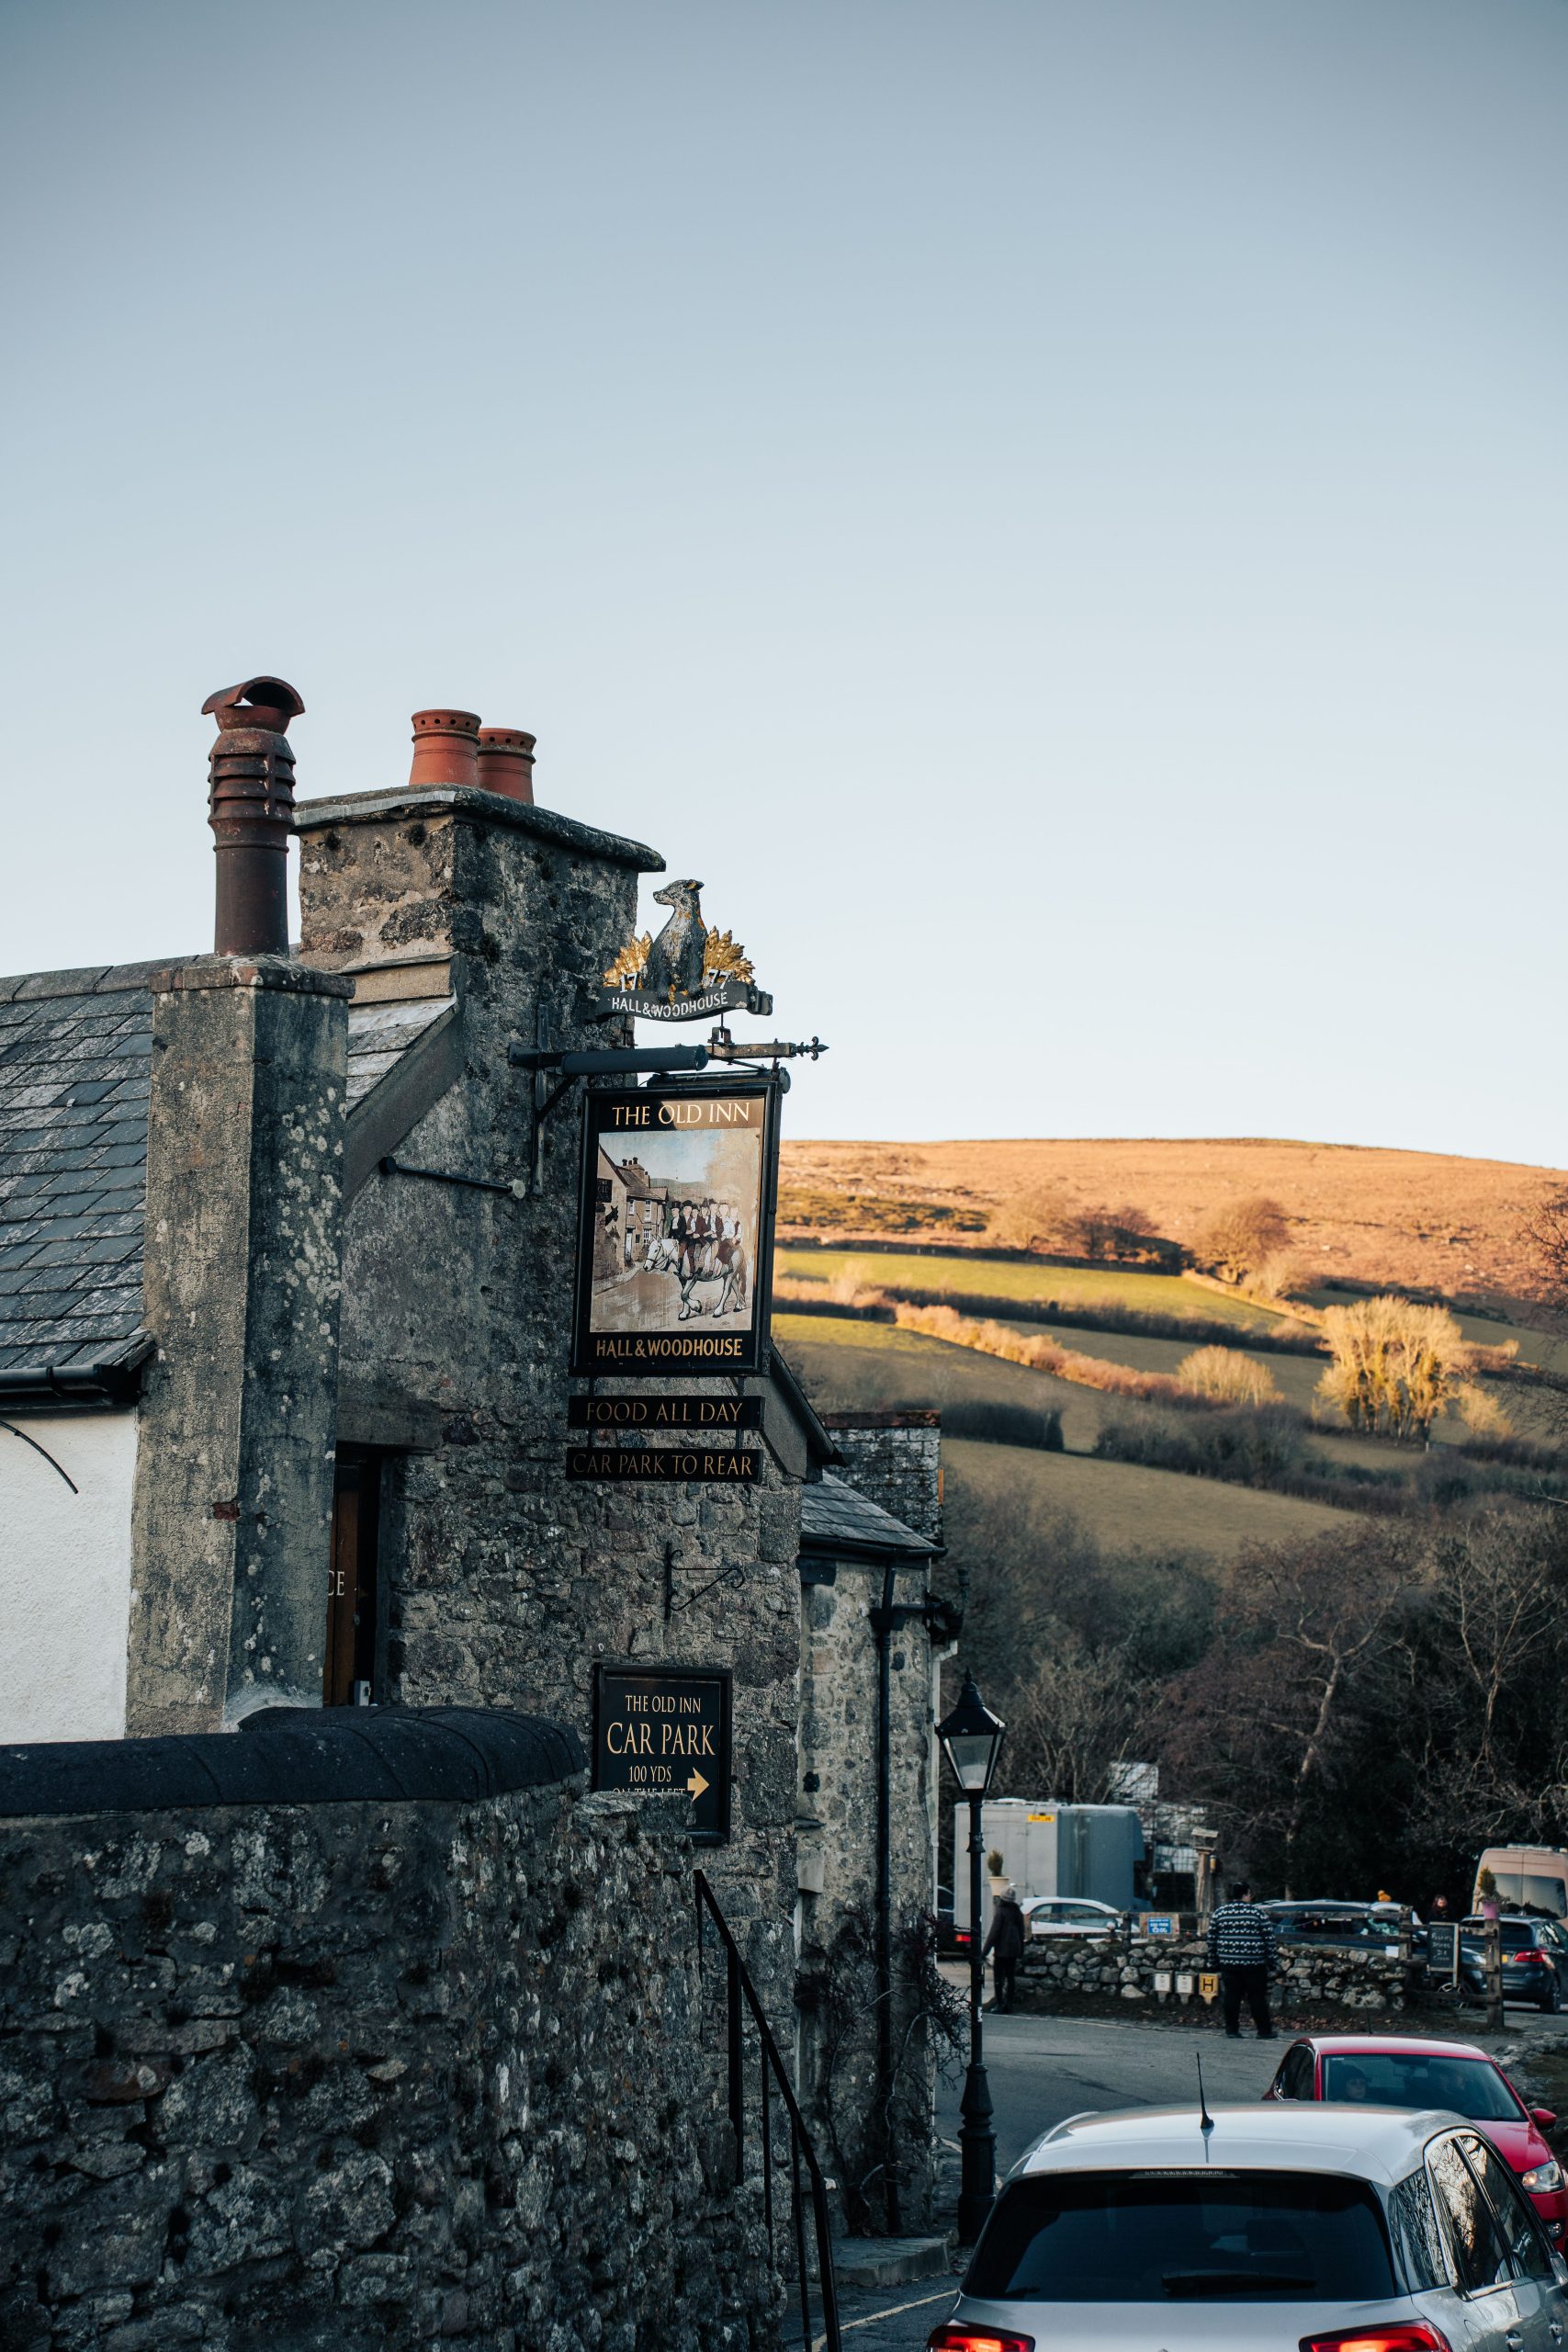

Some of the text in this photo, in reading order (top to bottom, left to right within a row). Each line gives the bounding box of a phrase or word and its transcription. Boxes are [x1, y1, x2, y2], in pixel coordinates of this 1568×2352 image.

[619, 969, 731, 992] 17 77
[612, 992, 728, 1018] HALL&WOODHOUSE
[612, 1102, 750, 1126] THE OLD INN
[596, 1338, 743, 1359] HALL&WOODHOUSE
[586, 1402, 743, 1422] FOOD ALL DAY
[572, 1453, 753, 1476] CAR PARK TO REAR
[625, 1695, 701, 1713] THE OLD INN
[607, 1722, 716, 1756] CAR PARK
[628, 1766, 671, 1782] 100 YDS
[1202, 1977, 1214, 1992] H
